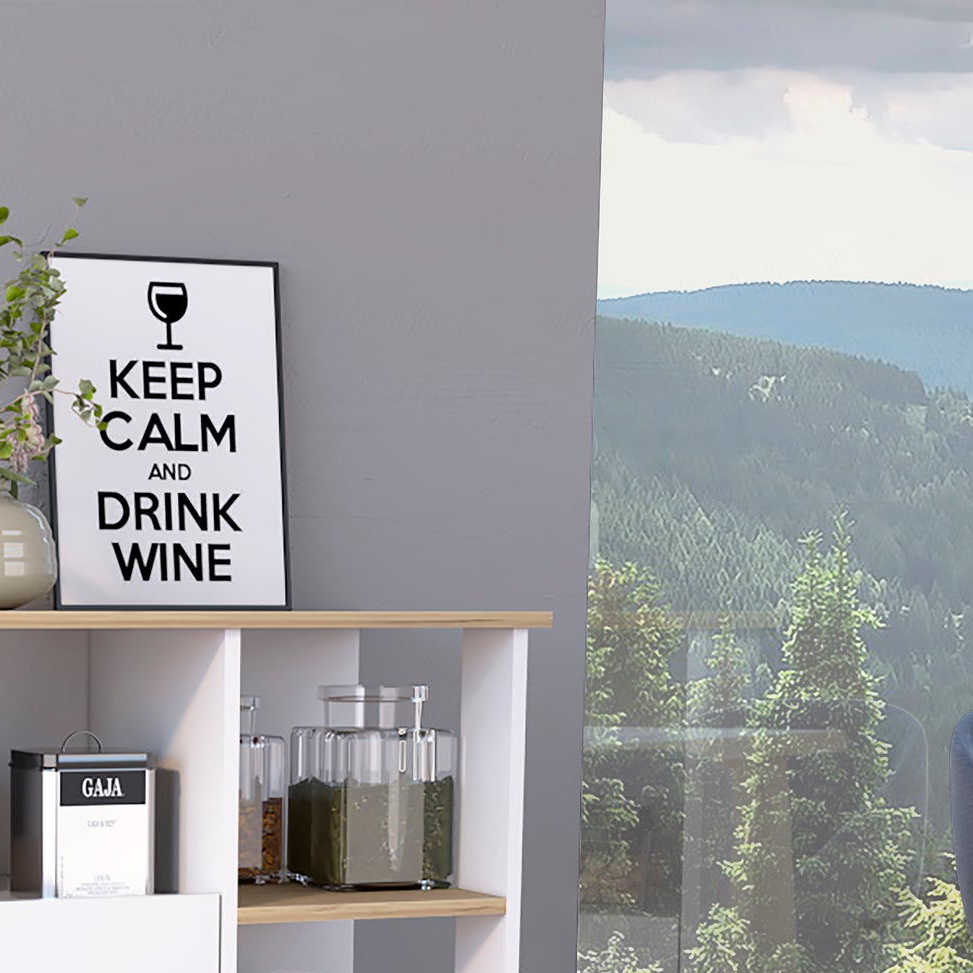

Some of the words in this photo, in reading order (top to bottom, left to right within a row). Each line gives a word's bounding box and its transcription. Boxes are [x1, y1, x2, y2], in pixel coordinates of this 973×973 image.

[109, 359, 223, 400] KEEP
[99, 411, 237, 452] CALM
[148, 463, 191, 480] AND
[97, 491, 242, 532] DRINK
[112, 542, 232, 582] WINE
[81, 777, 123, 798] GAJA
